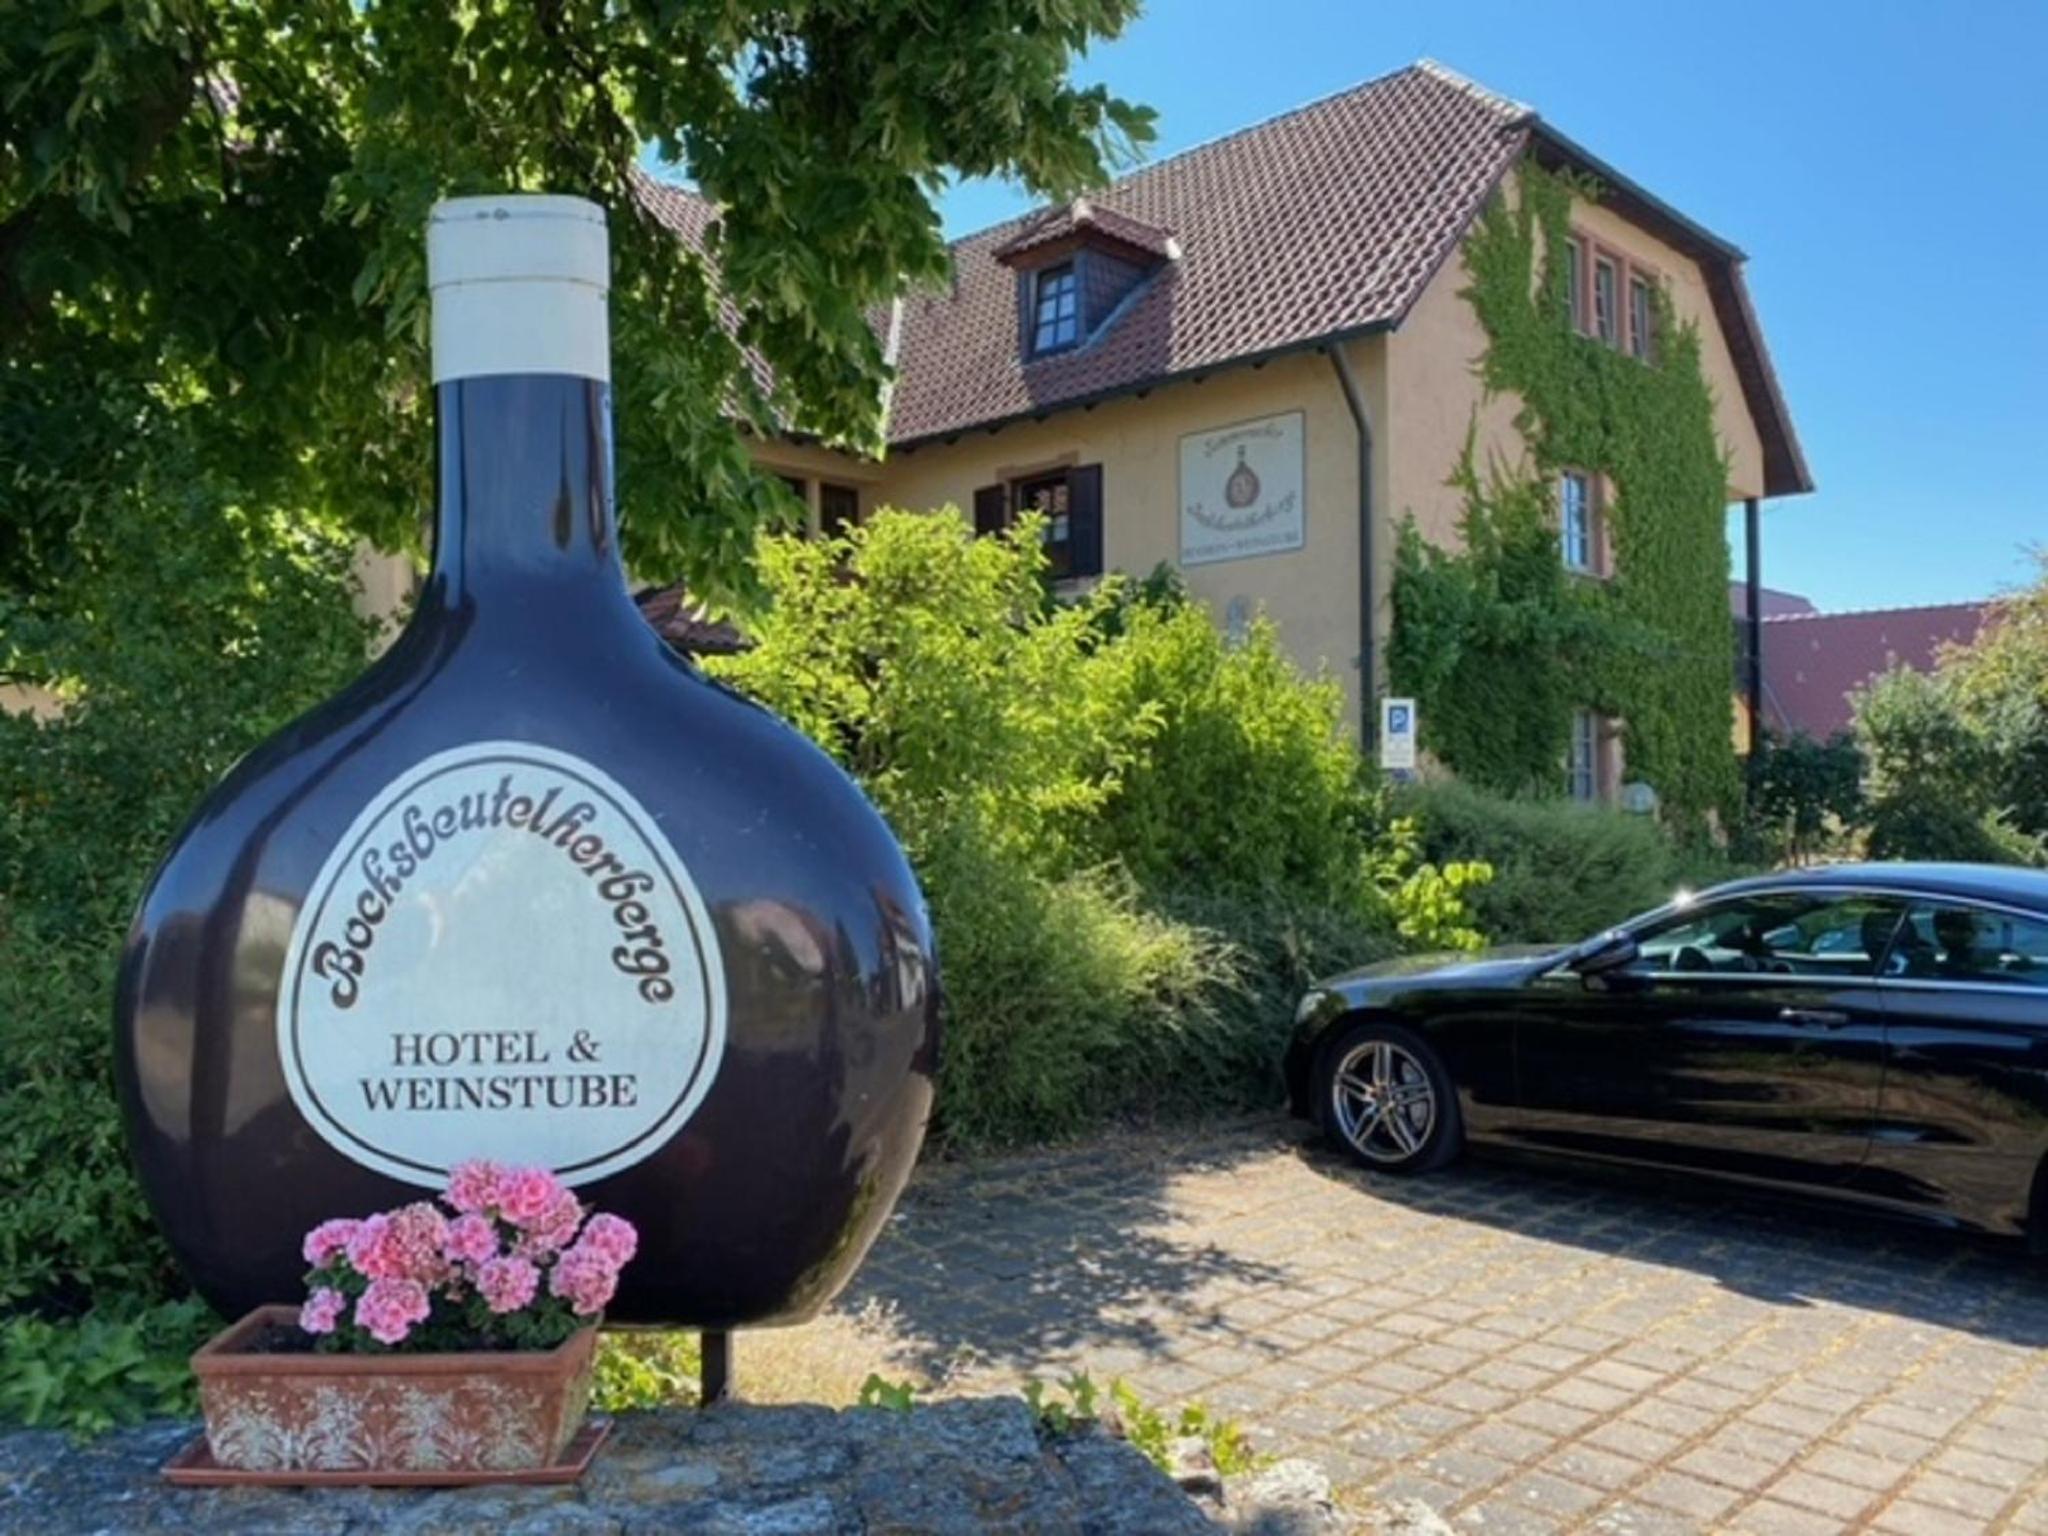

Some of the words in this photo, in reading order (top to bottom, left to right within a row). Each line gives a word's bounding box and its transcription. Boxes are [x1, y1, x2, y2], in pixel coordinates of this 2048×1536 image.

[1391, 709, 1406, 730] P
[313, 775, 674, 1010] Bocksbeutelherberge
[390, 1031, 548, 1066] HOTEL
[565, 1029, 602, 1063] &
[360, 1073, 638, 1111] WEINSTUBE
